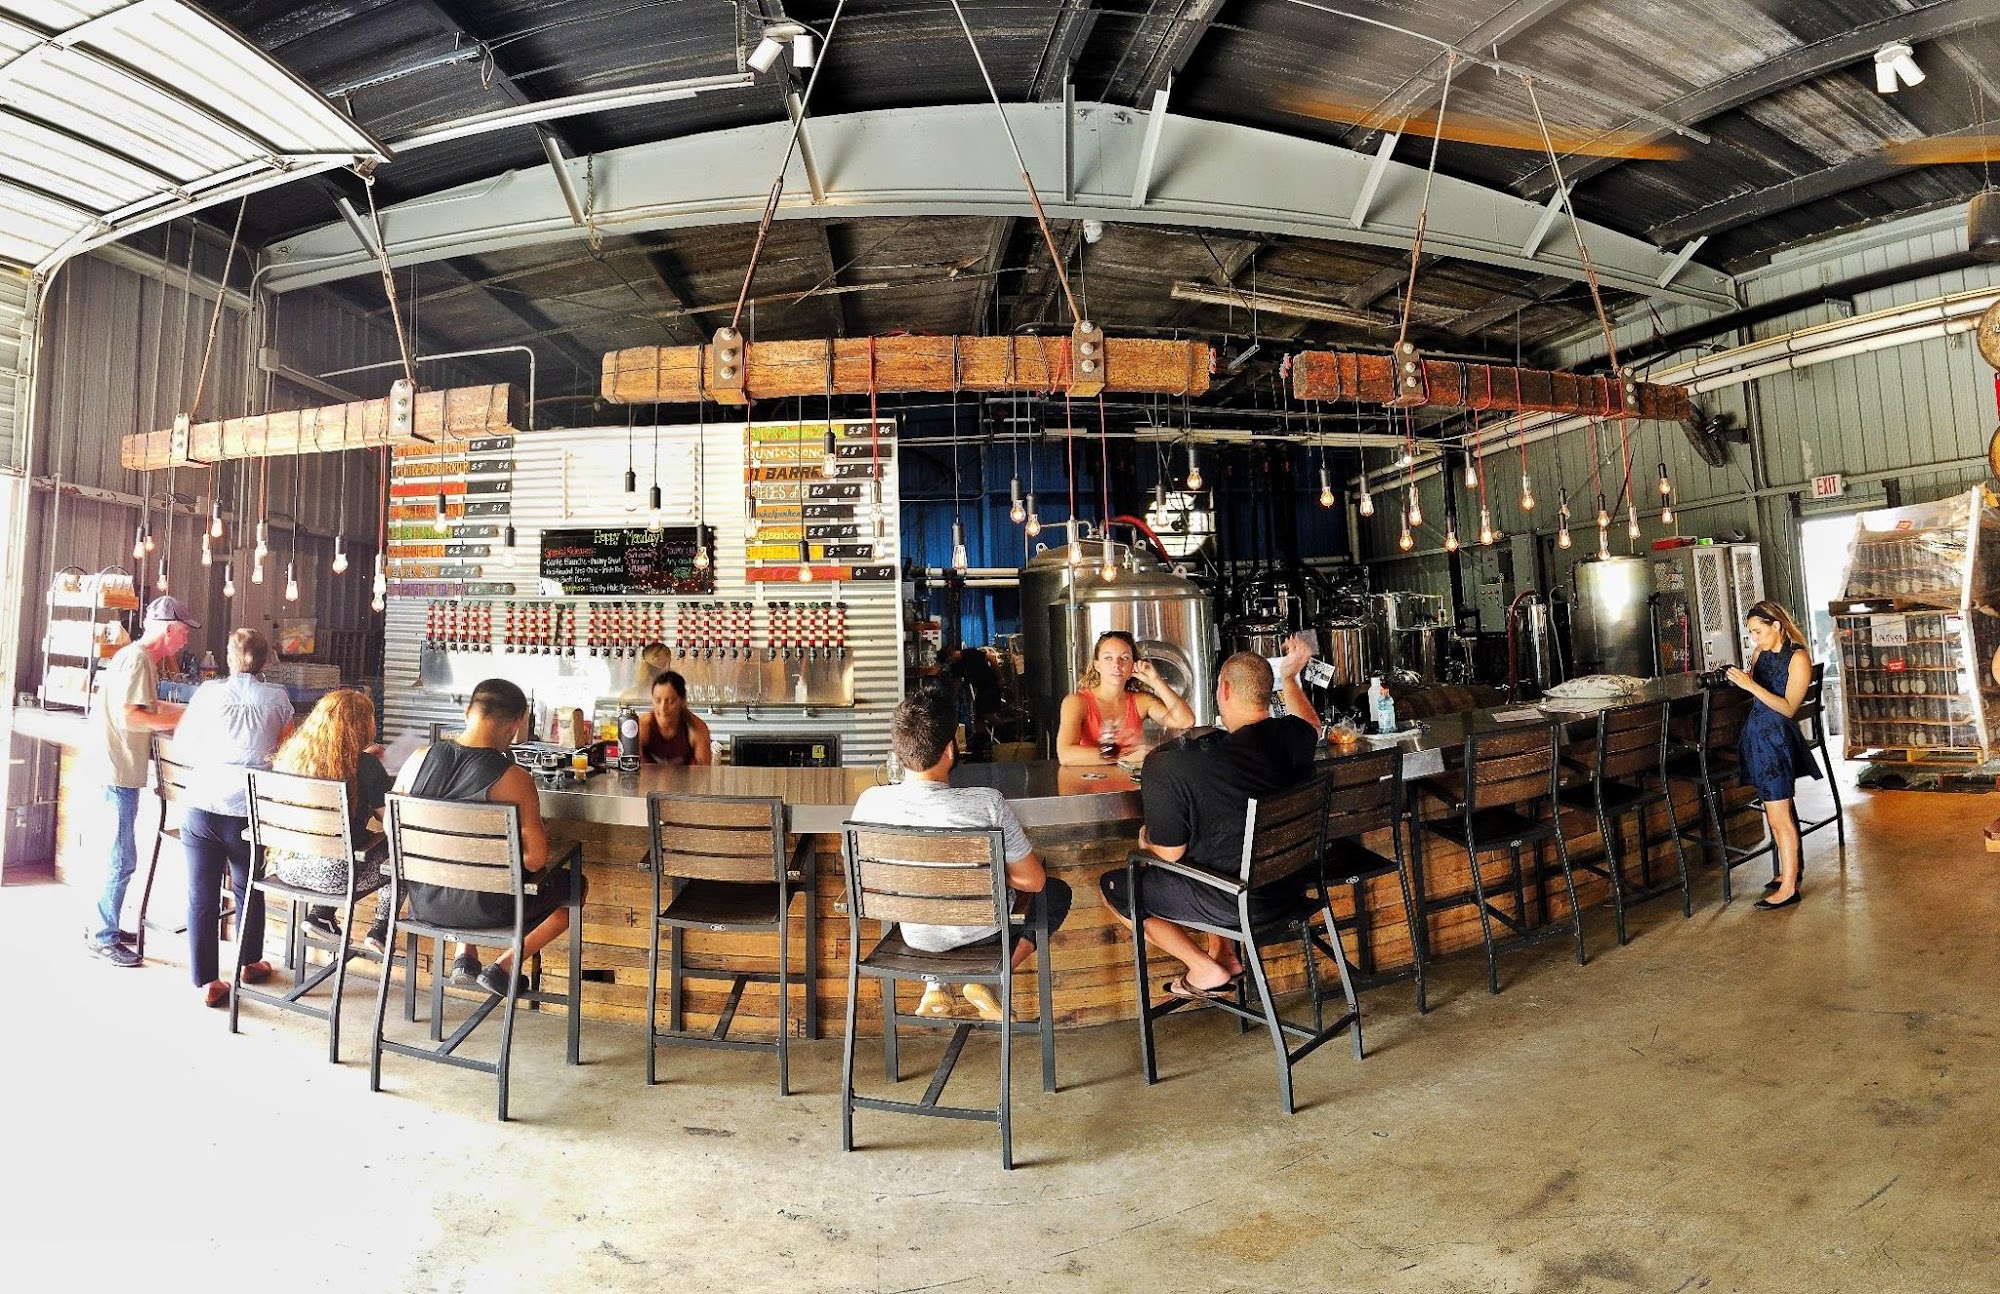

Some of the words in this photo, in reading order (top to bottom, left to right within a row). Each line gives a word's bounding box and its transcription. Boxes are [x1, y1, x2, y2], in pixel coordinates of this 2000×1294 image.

[879, 426, 890, 434] $6
[765, 466, 823, 480] BARRE
[1817, 476, 1836, 495] EXIT
